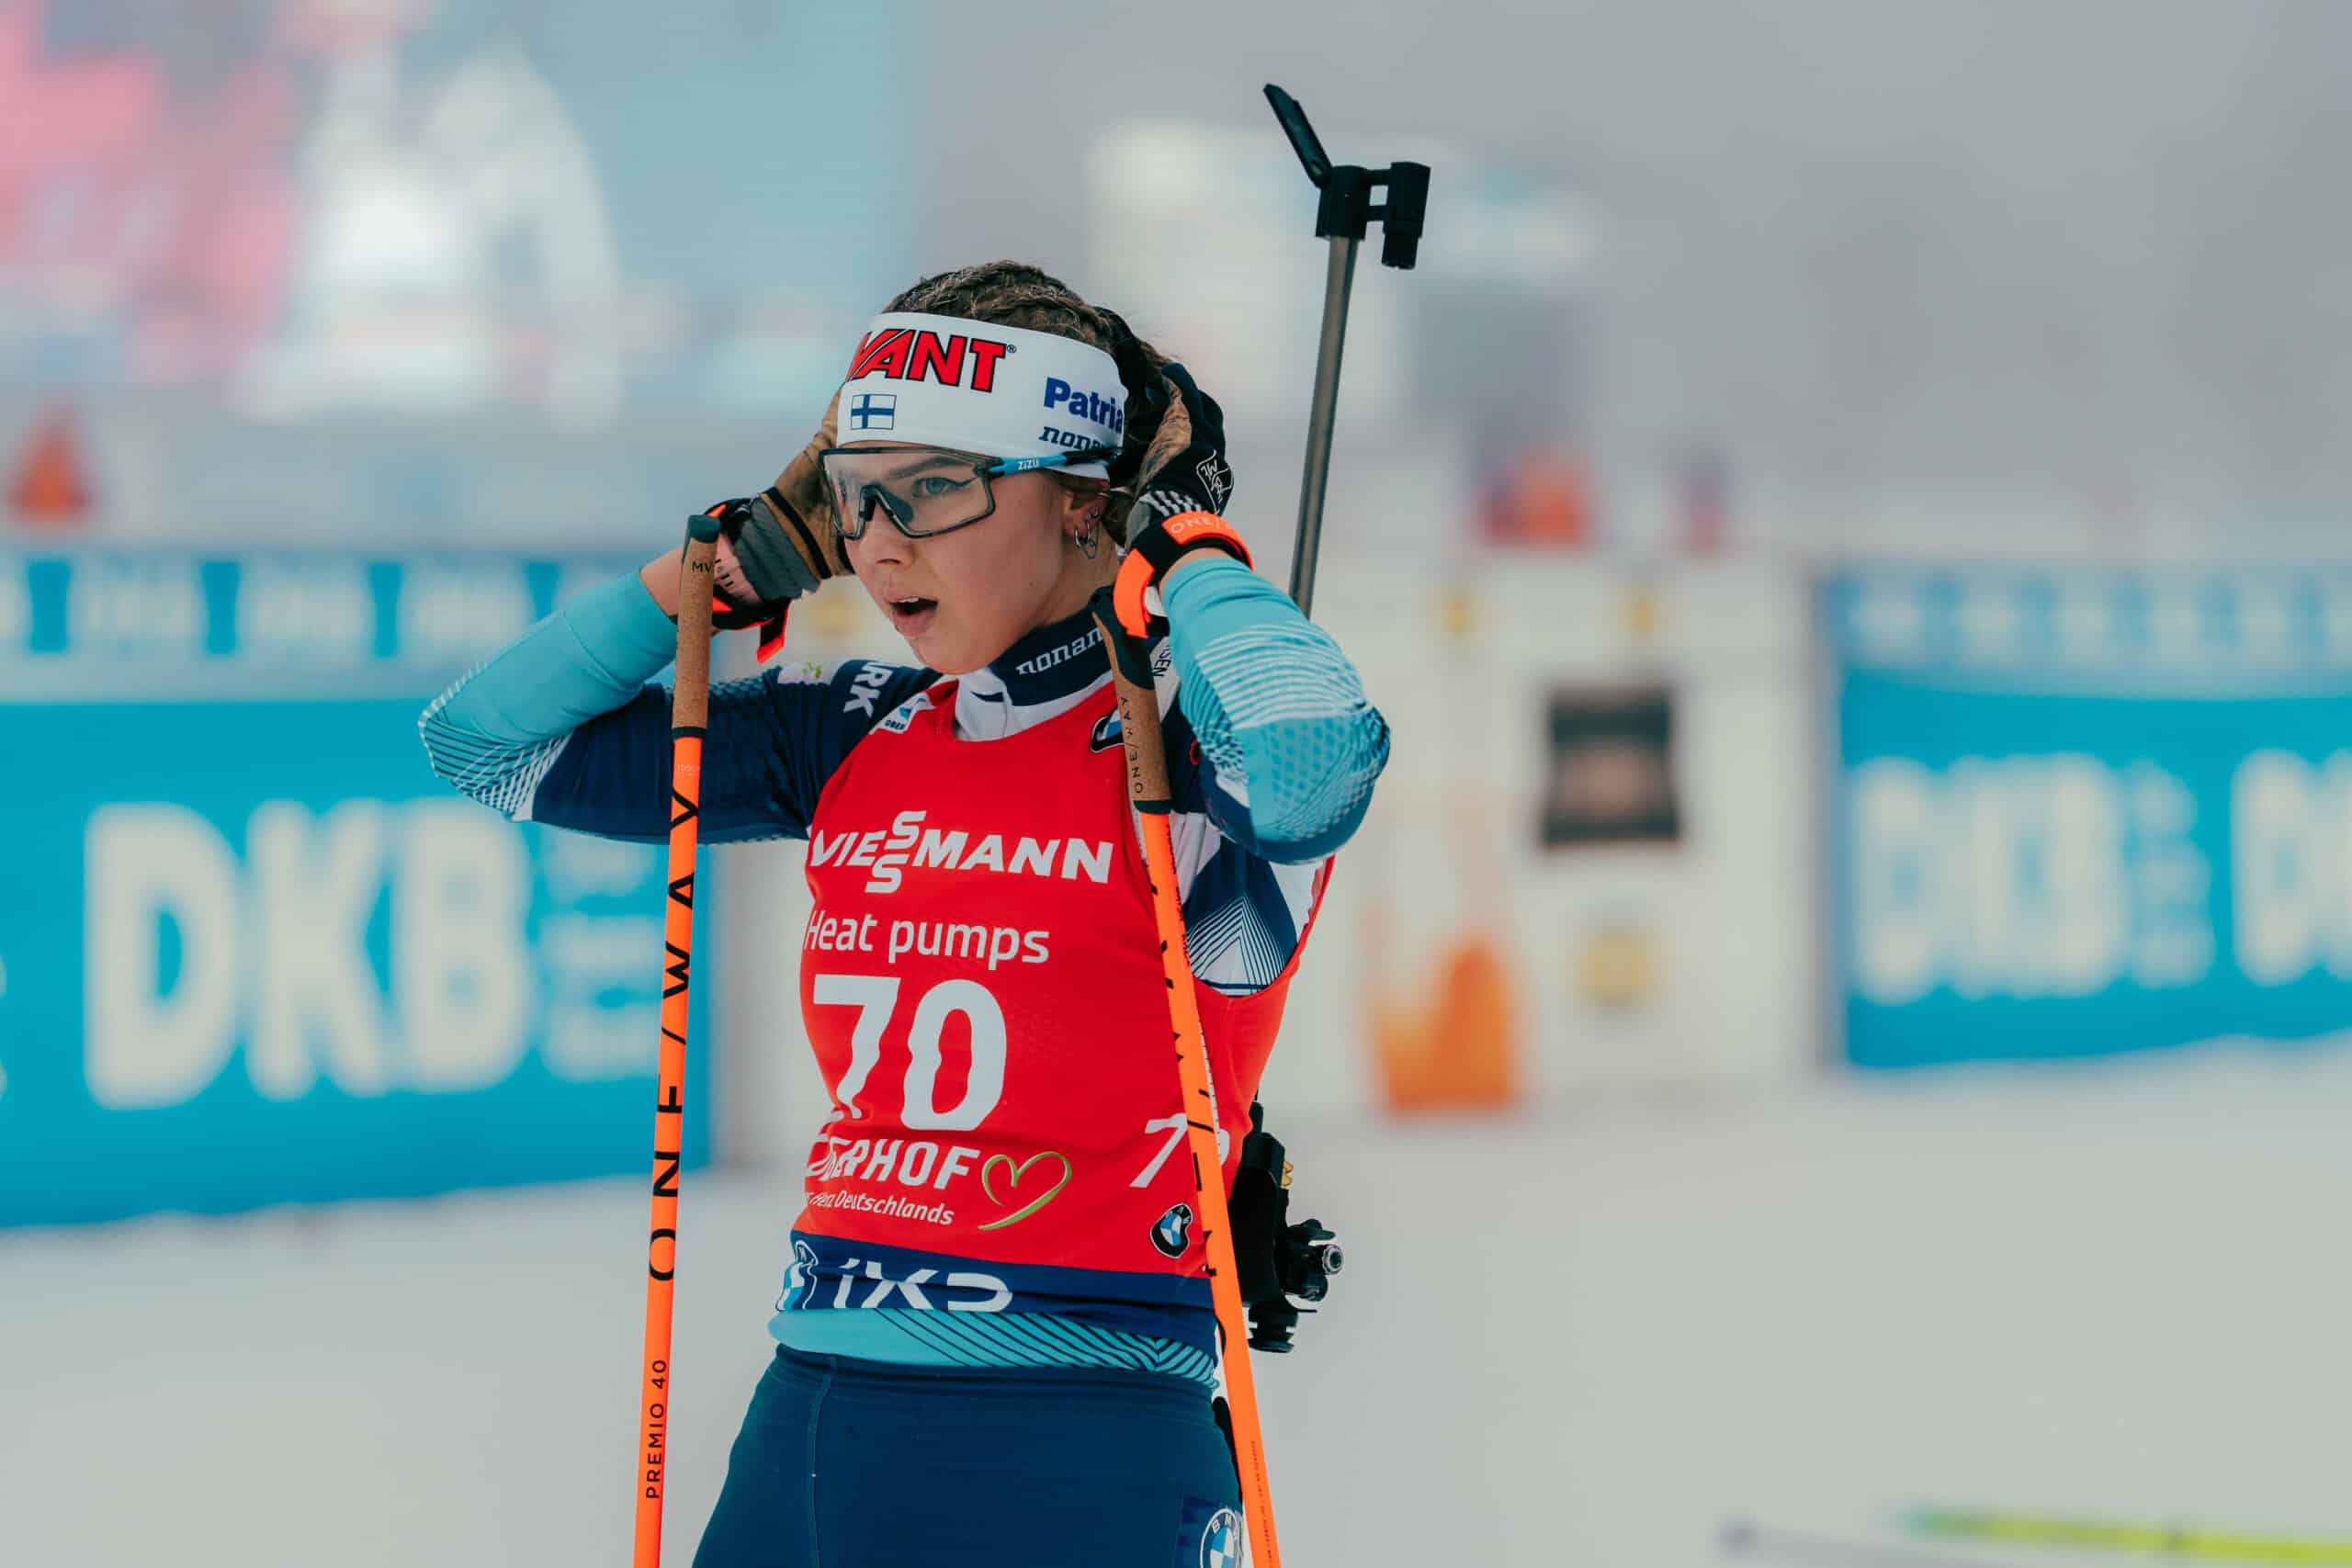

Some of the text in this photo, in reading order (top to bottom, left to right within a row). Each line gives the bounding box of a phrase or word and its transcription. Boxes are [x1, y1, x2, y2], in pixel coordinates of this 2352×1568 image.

[809, 810, 1114, 894] VIESSMANN
[804, 909, 1050, 970] Heat pumps
[813, 974, 1007, 1132] 70
[646, 1359, 668, 1499] PREMIO 40
